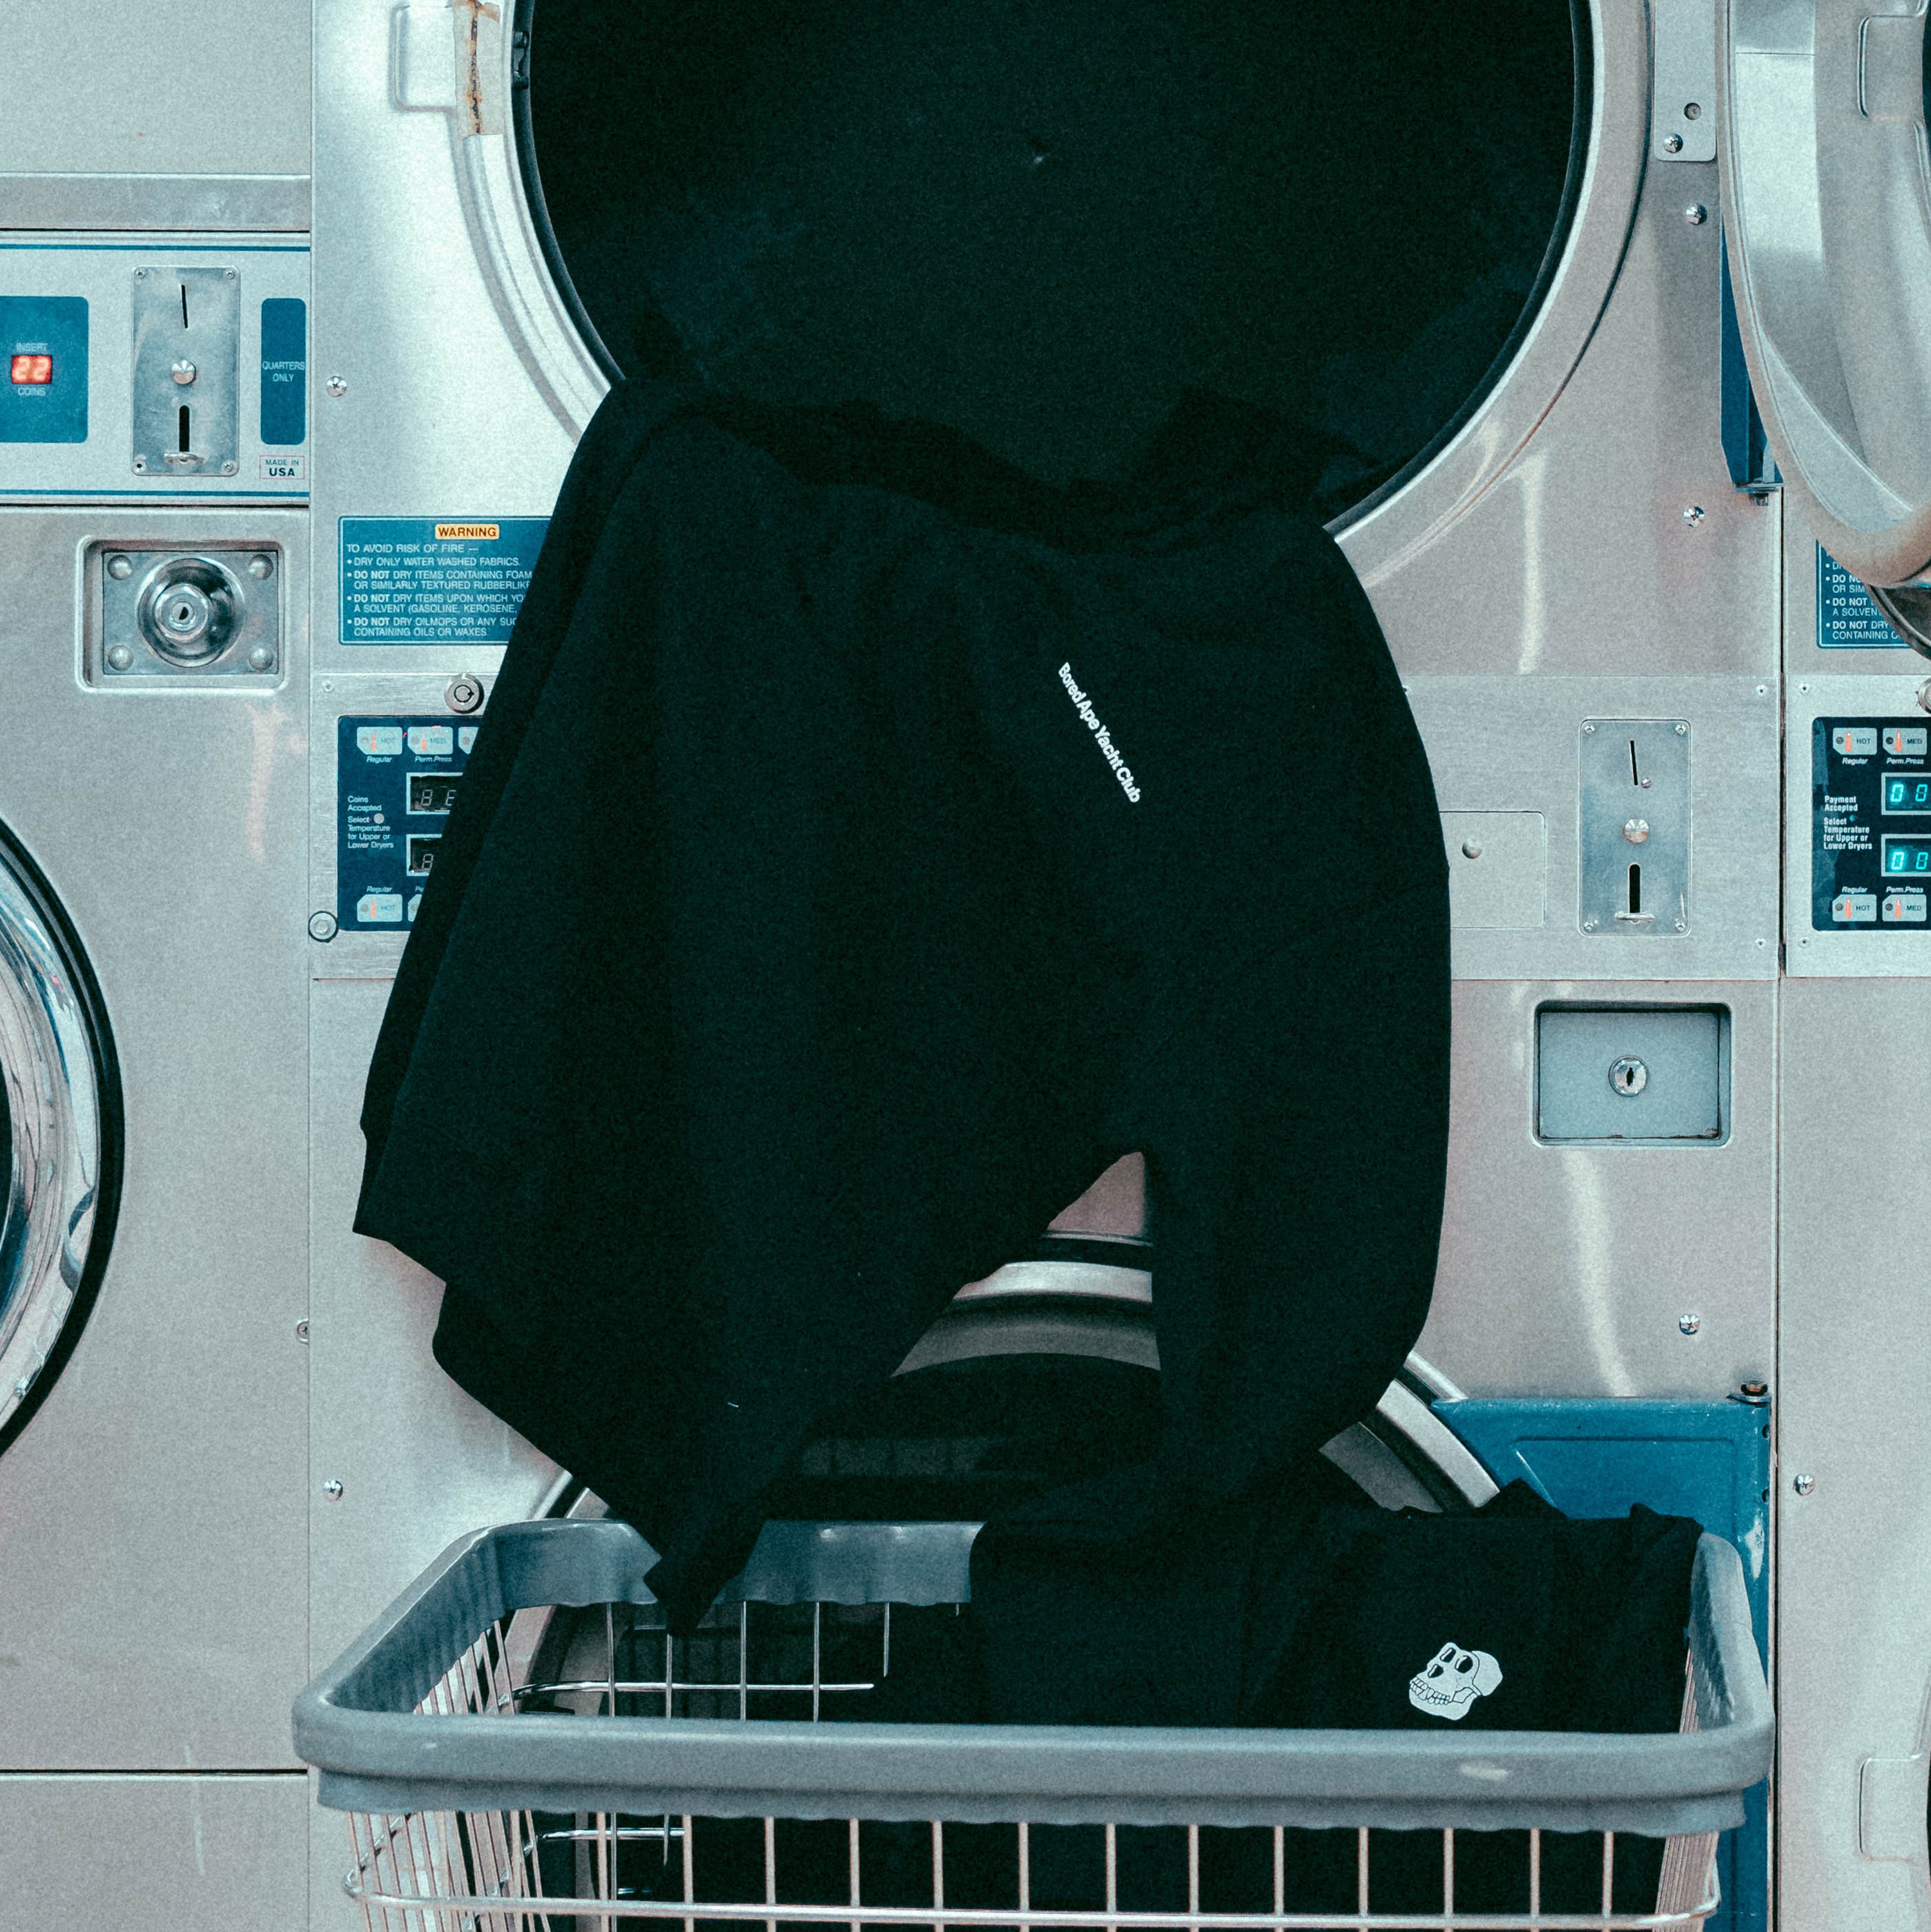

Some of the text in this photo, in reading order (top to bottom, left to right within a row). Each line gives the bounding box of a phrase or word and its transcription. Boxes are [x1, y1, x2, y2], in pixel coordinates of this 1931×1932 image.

[16, 342, 49, 352] INSERT
[14, 355, 50, 380] 22
[262, 361, 305, 370] QUARTERS
[272, 373, 294, 382] ONLY
[17, 387, 46, 396] COINS
[269, 467, 295, 476] USA
[438, 527, 497, 537] WARNING
[346, 544, 360, 553] TO
[362, 544, 393, 553] AVOID
[396, 544, 420, 553] RISK
[424, 544, 438, 553] OF
[441, 544, 465, 553] FIRE
[354, 558, 373, 566] DRY
[376, 558, 401, 566] ONLY
[404, 558, 434, 566] WATER
[438, 558, 477, 566] WASHED
[354, 570, 532, 579] DO NOT DRY ITEMS CONTAINING FOAM
[1832, 574, 1846, 583] DO
[354, 581, 368, 590] OR
[371, 581, 418, 590] SIMILARLY
[421, 581, 471, 590] TEXTURED
[1833, 585, 1846, 593] OR
[354, 594, 526, 603] DO NOT DRY ITEMS UPON WHICH YO
[1849, 597, 1868, 606] NOT
[353, 605, 518, 614] A SOLVENT (GASOLINE, KEROSENE,
[1833, 608, 1881, 616] A SOLVEN
[354, 617, 368, 626] DO
[371, 617, 390, 626] NOT
[393, 617, 413, 626] DRY
[415, 617, 458, 626] OILMOPS
[460, 617, 474, 626] OR
[477, 617, 496, 626] ANY
[1833, 621, 1846, 629] DO
[1849, 621, 1868, 629] NOT
[354, 628, 489, 636] CONTAINING OILS OR WAXES.
[1833, 631, 1889, 639] CONTAINING
[1058, 662, 1141, 803] Bored Ape Yacht Club
[1824, 795, 1856, 804] Payment
[1824, 804, 1858, 812] Accepted
[1836, 834, 1858, 842] Upper
[1848, 842, 1872, 850] Dryers
